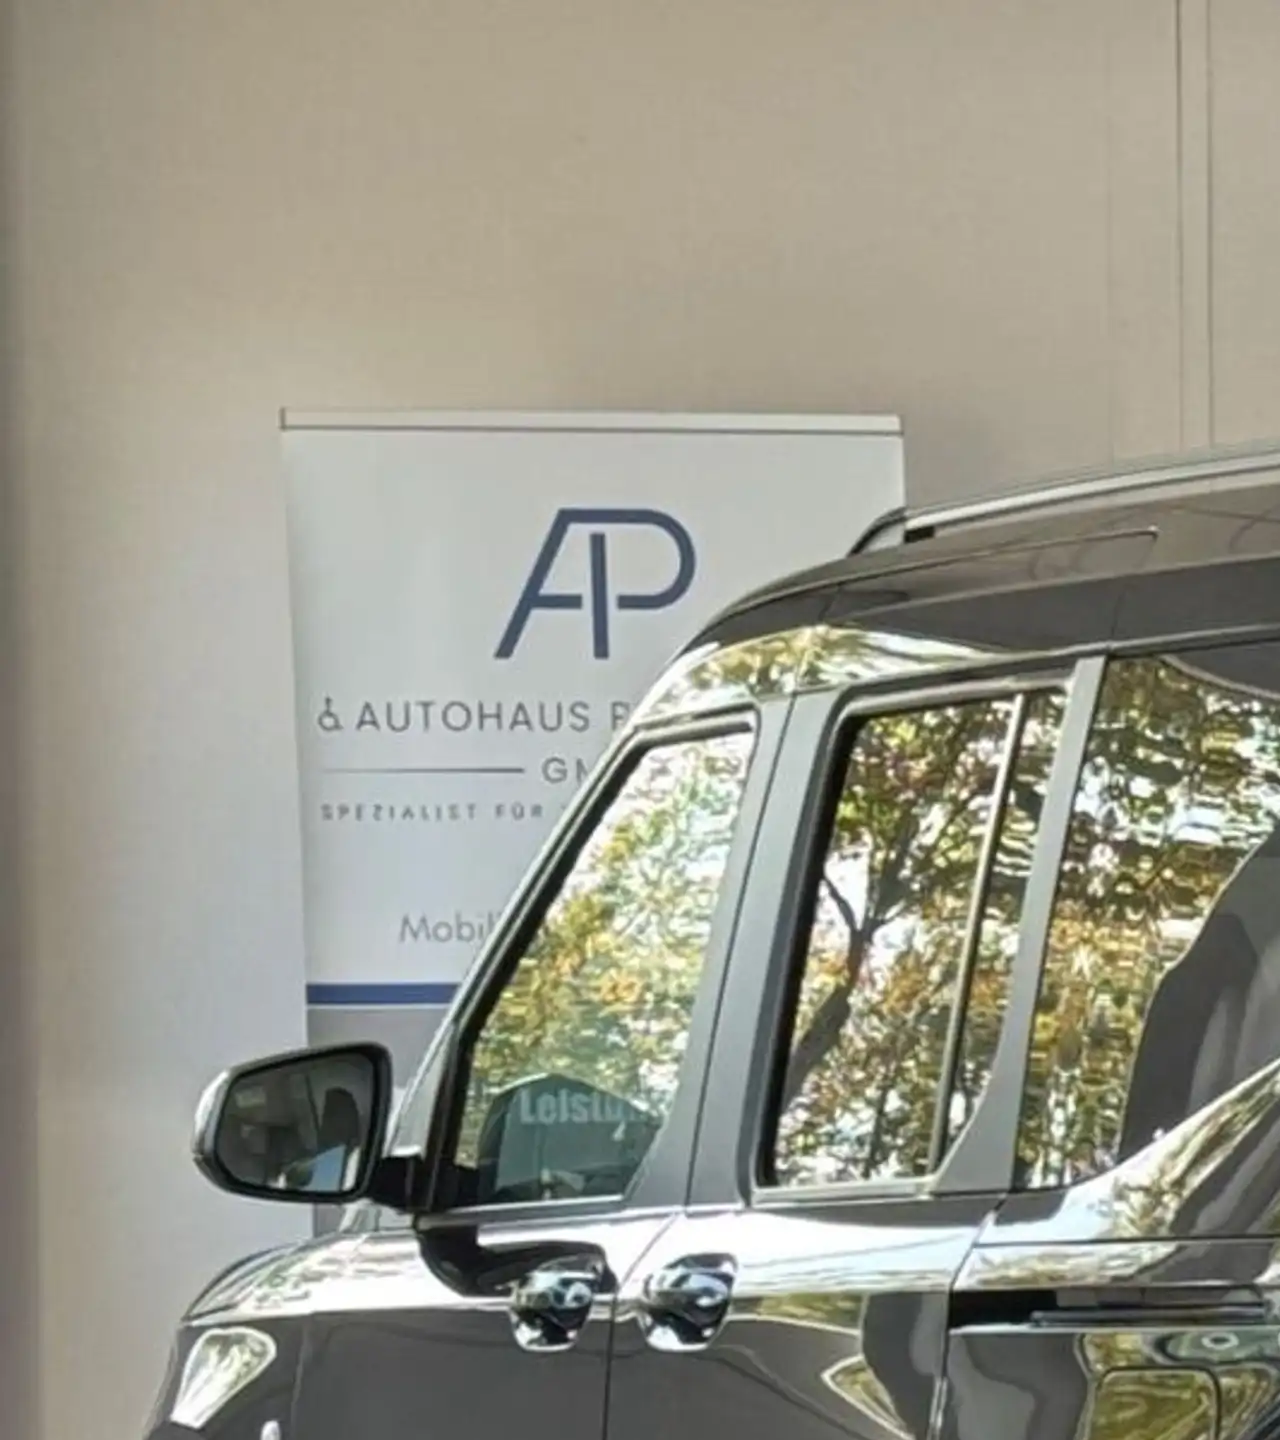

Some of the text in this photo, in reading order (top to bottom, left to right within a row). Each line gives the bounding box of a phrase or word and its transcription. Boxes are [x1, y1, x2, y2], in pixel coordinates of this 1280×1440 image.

[494, 508, 696, 658] AP
[356, 699, 590, 733] AUTOHAUS
[320, 803, 476, 821] SPEZIALIST
[494, 801, 543, 821] FÜR
